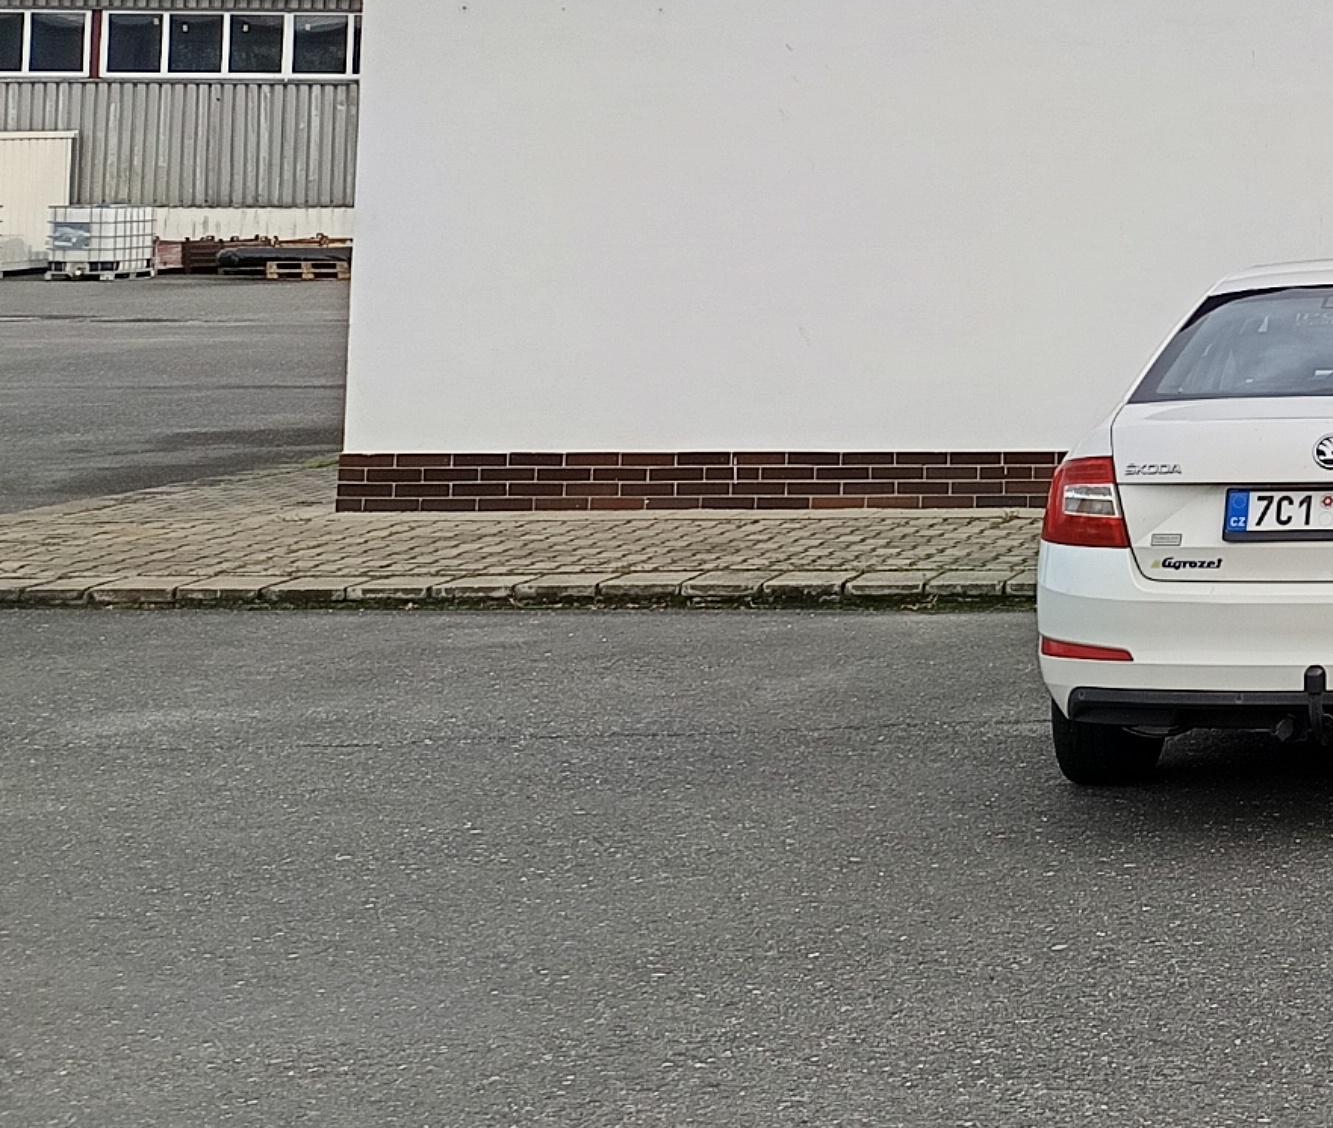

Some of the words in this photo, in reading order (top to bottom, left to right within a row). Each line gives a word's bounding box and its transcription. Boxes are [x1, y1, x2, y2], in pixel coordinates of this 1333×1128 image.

[1125, 463, 1182, 475] ŠKODA
[1255, 495, 1312, 526] 7C1
[1230, 517, 1246, 527] CZ
